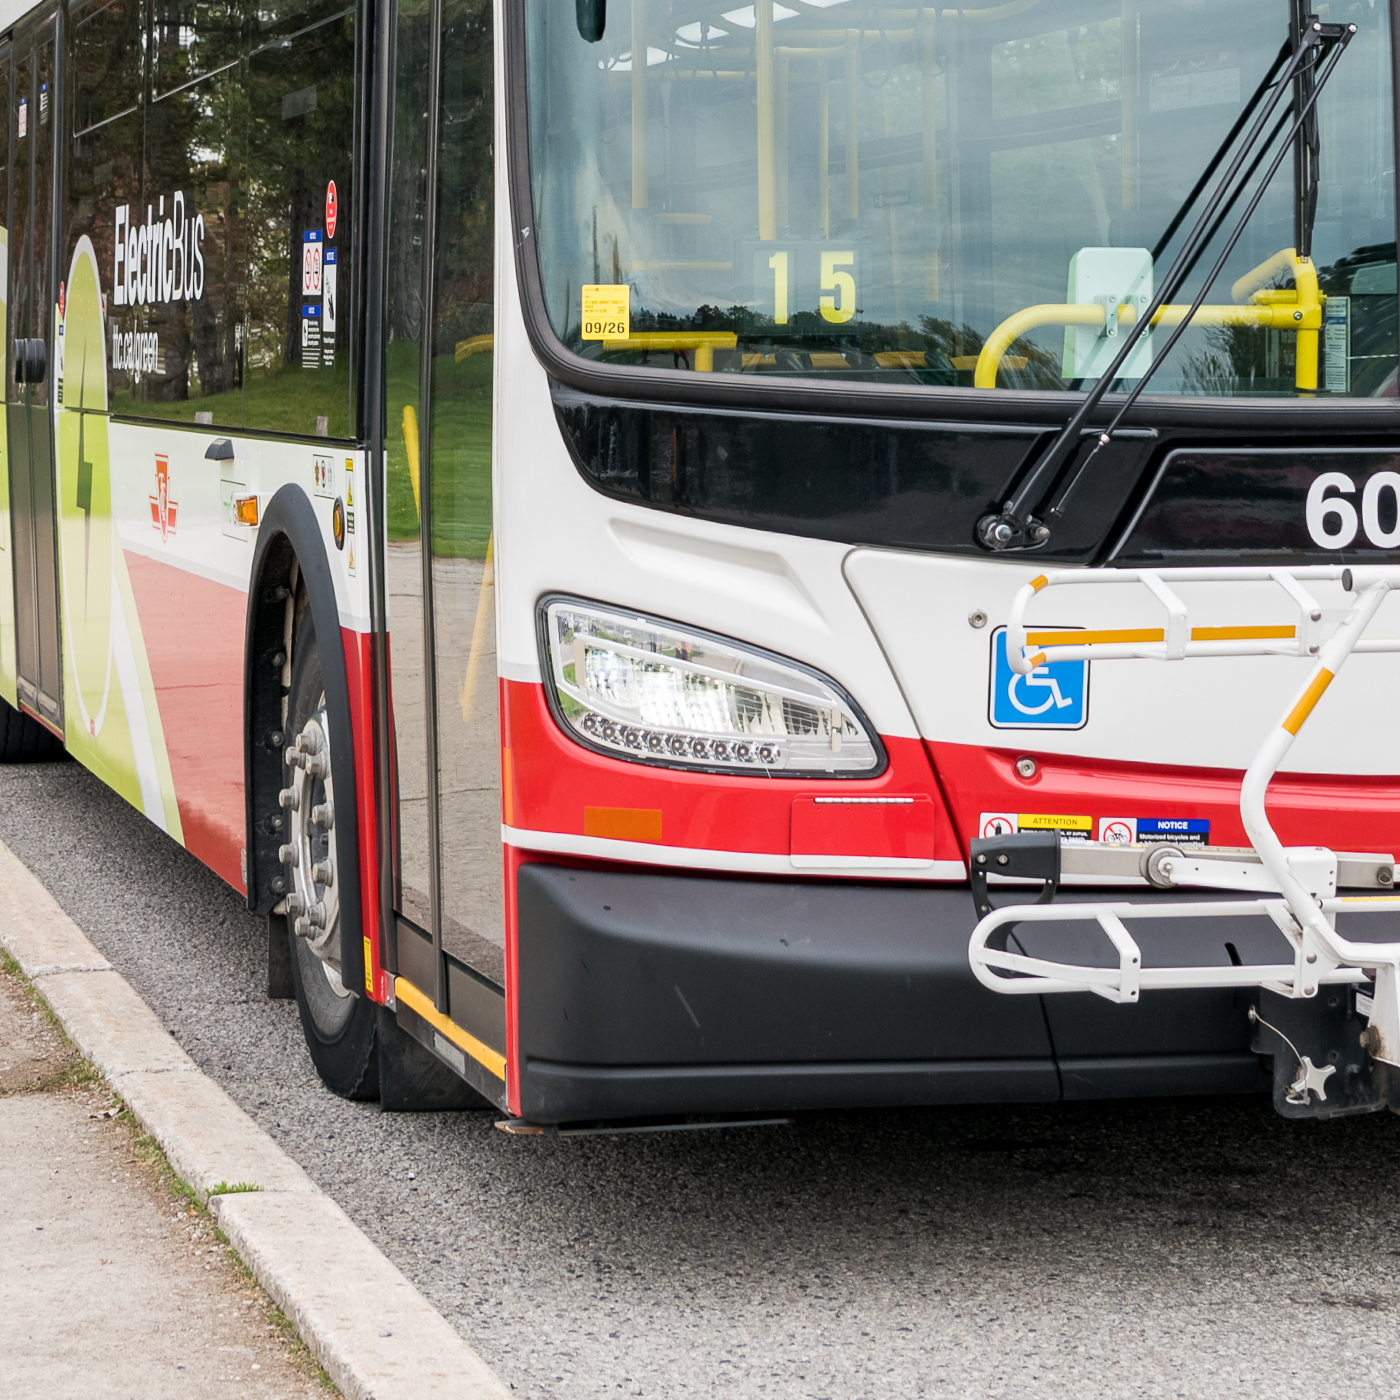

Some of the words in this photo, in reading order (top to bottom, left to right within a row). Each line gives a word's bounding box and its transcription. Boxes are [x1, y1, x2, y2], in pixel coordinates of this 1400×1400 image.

[113, 190, 205, 307] ElectricBus
[585, 322, 625, 334] 09/26
[112, 319, 159, 384] ttc.ca/green
[1032, 817, 1078, 826] ATTENTION
[1157, 820, 1189, 830] NOTICE
[1166, 833, 1189, 841] bicycles
